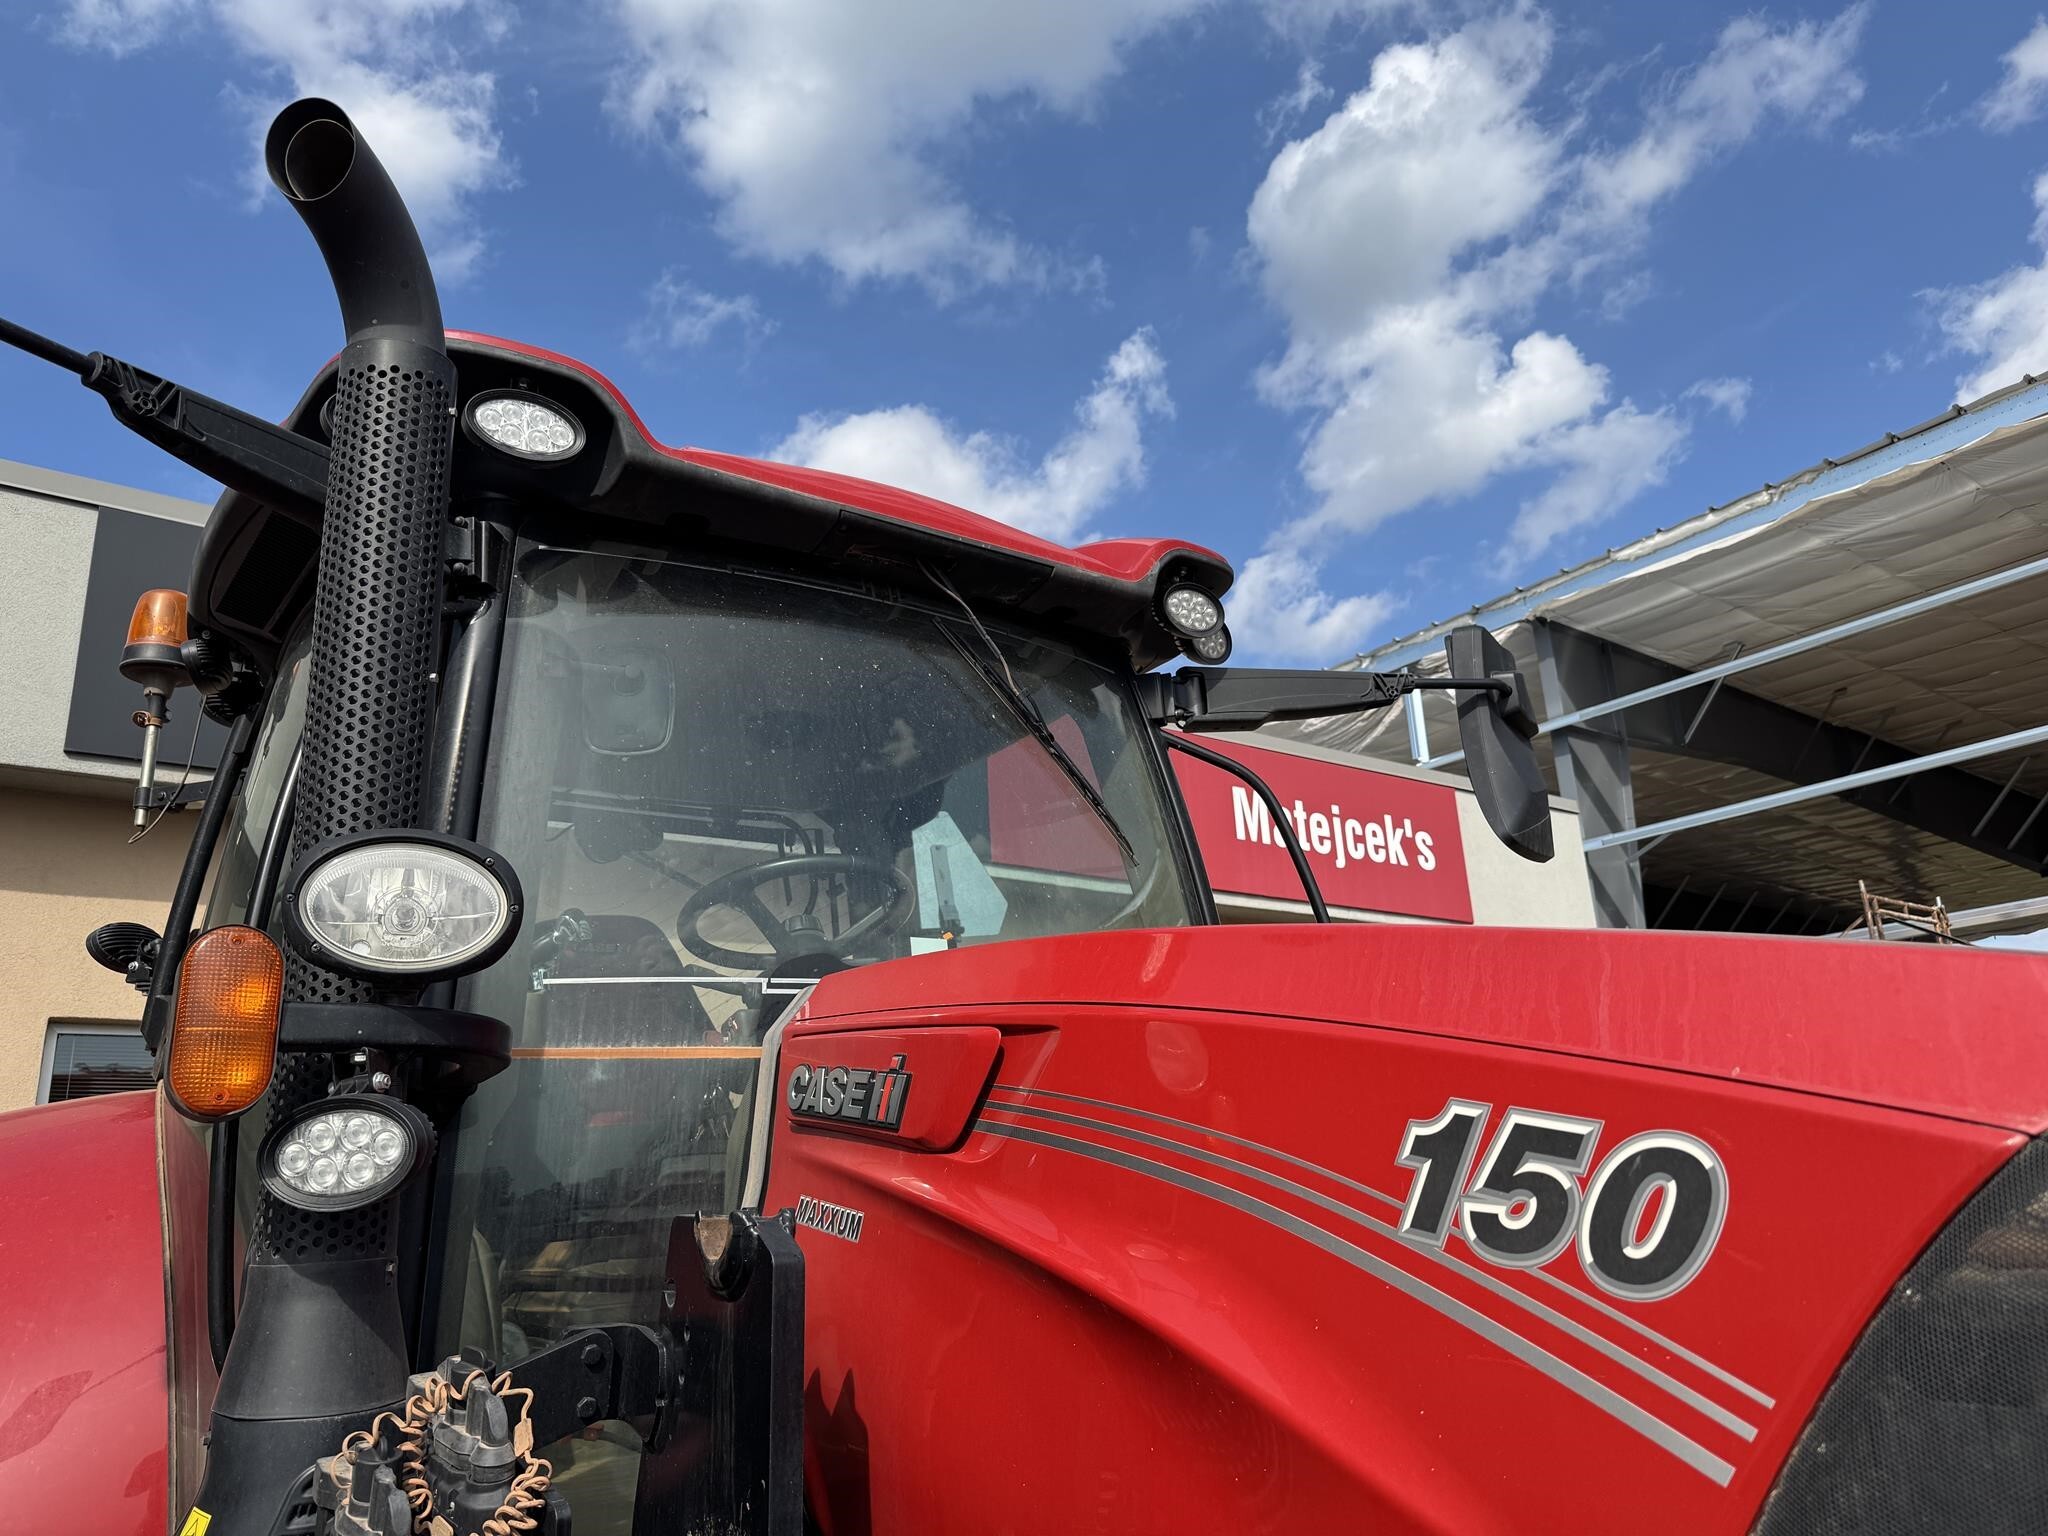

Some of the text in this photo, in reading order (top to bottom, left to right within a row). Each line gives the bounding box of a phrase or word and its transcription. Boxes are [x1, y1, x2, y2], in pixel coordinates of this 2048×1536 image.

[787, 1063, 872, 1120] CASE
[795, 1194, 865, 1243] MAXXUM
[1394, 1097, 1730, 1303] 150
